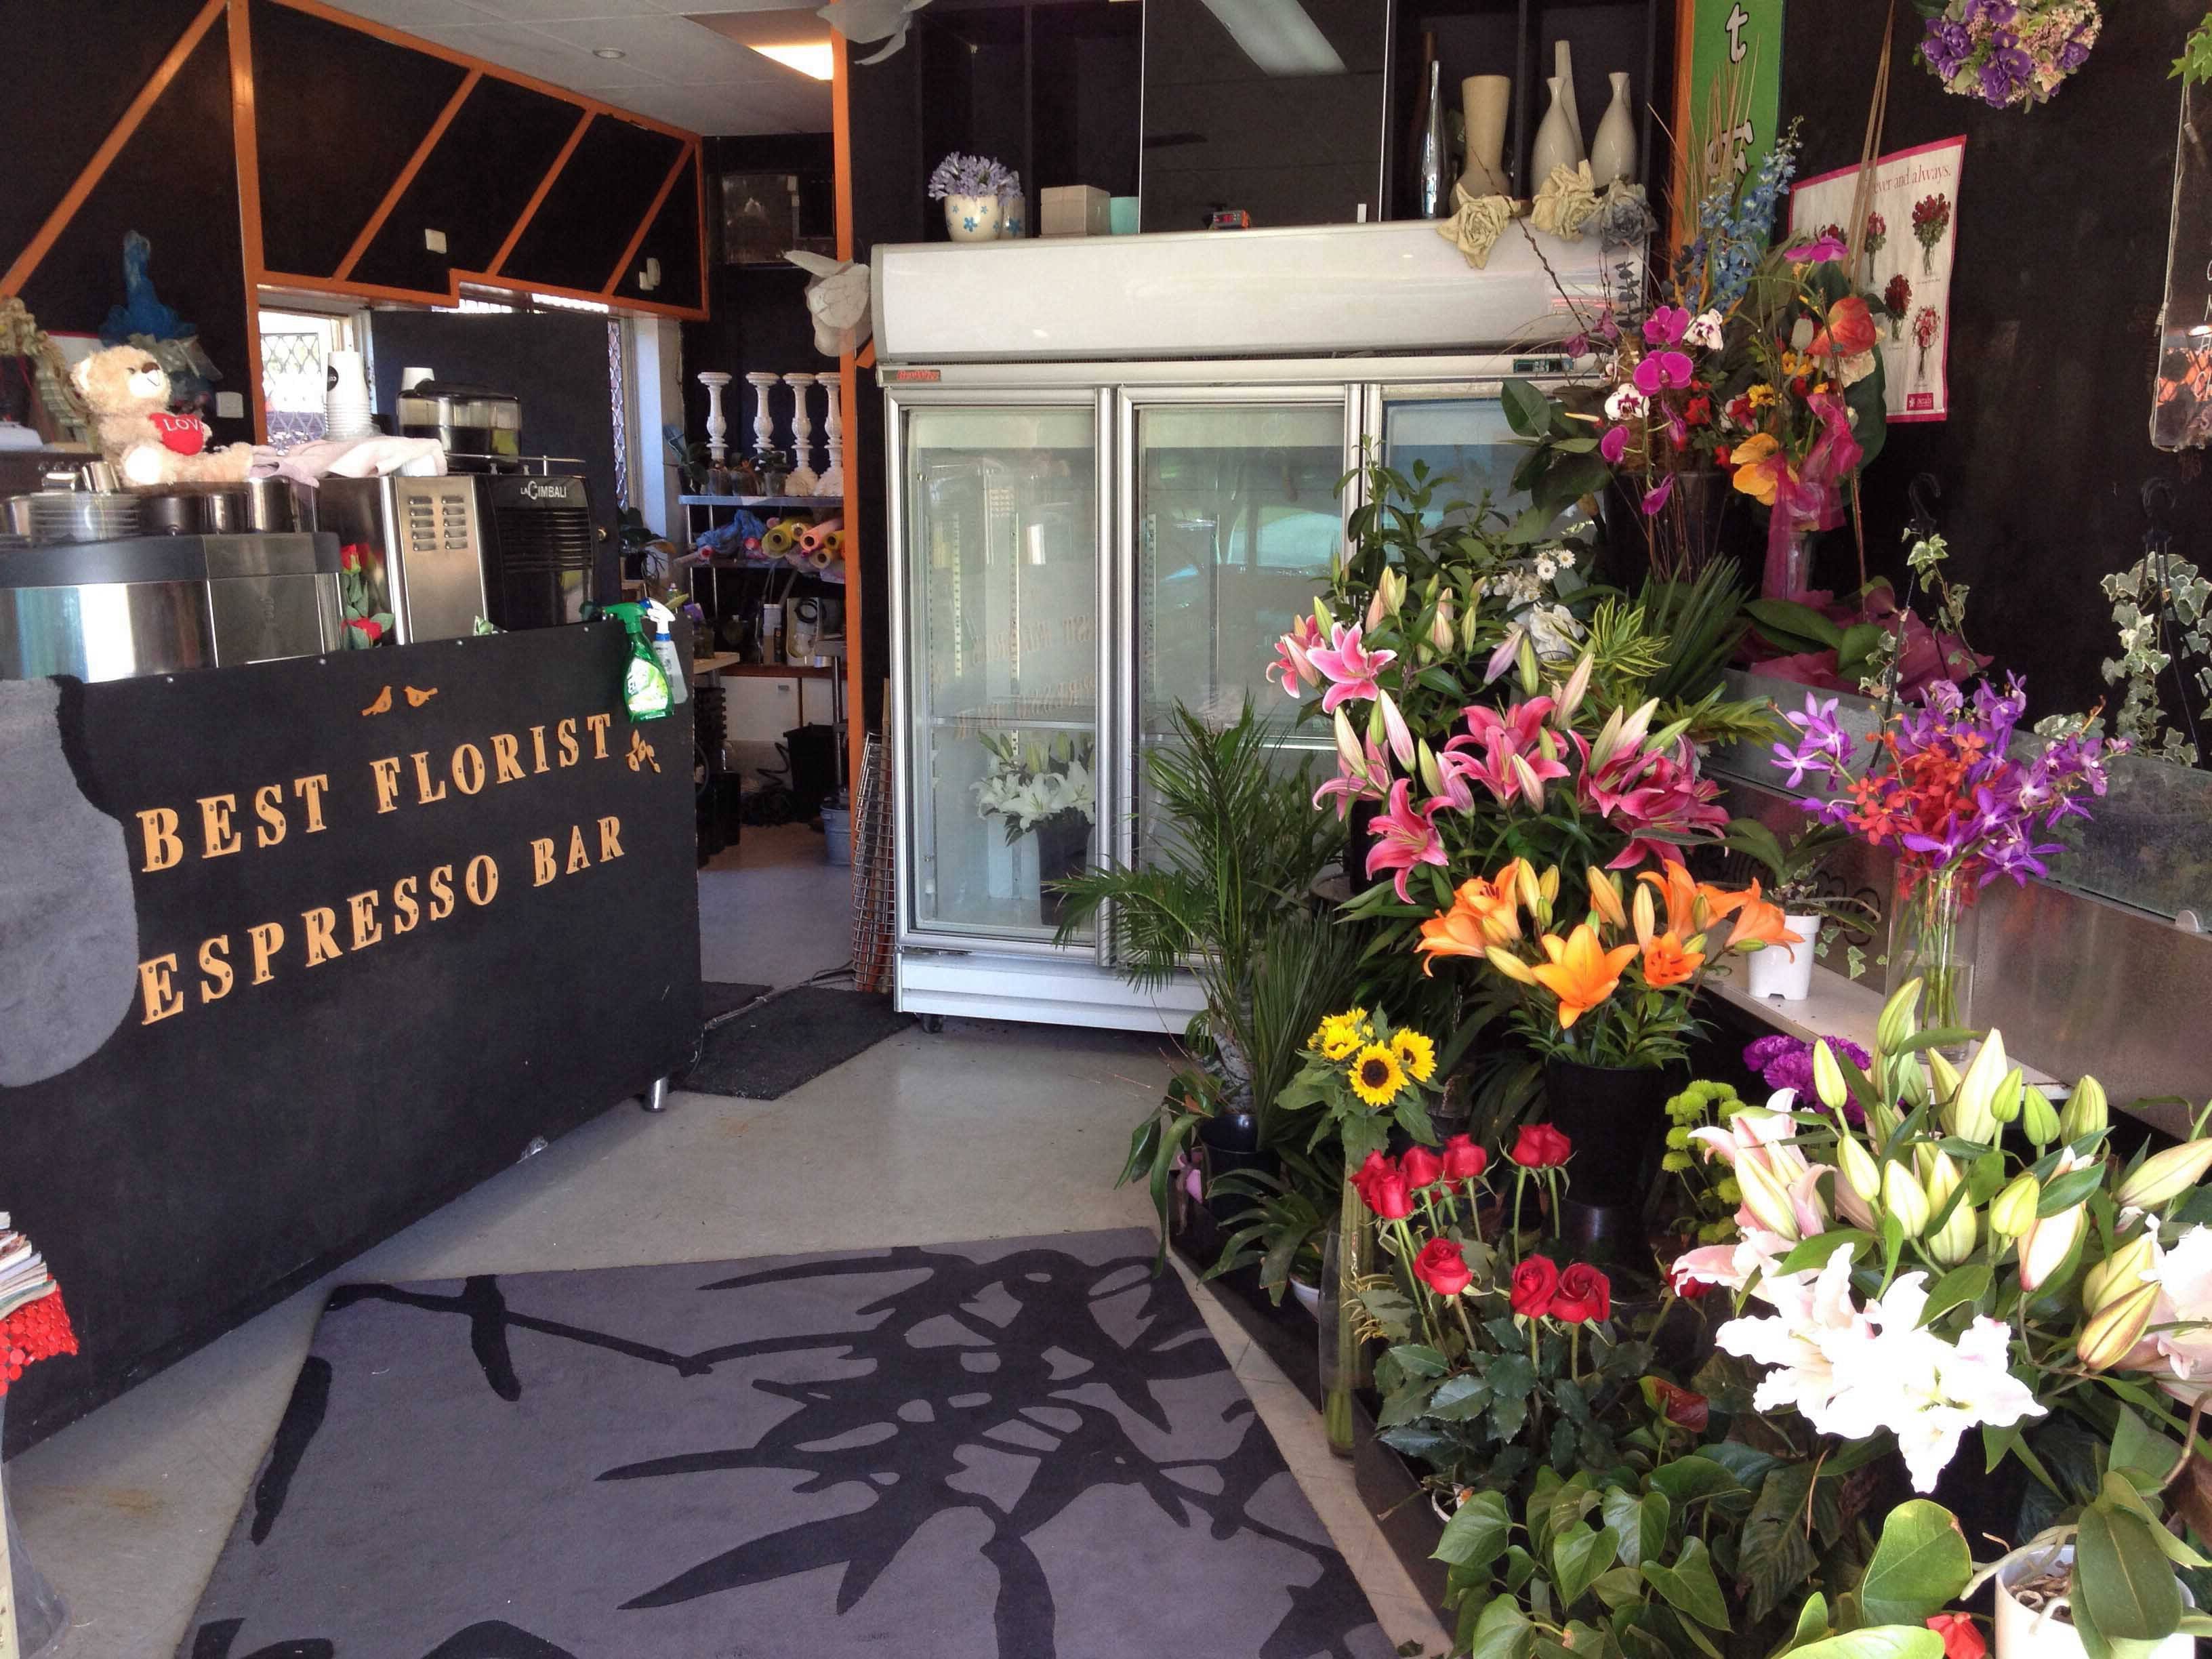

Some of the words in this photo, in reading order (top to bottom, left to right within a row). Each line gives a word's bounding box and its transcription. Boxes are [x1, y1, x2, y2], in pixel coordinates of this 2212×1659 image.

[1893, 167, 1909, 189] and
[1911, 164, 1951, 184] always.
[527, 480, 567, 500] CIMBALI
[136, 775, 328, 872] BEST
[370, 713, 611, 814] FLORIST
[138, 854, 499, 1025] ESPRESSO
[531, 816, 624, 886] BAR
